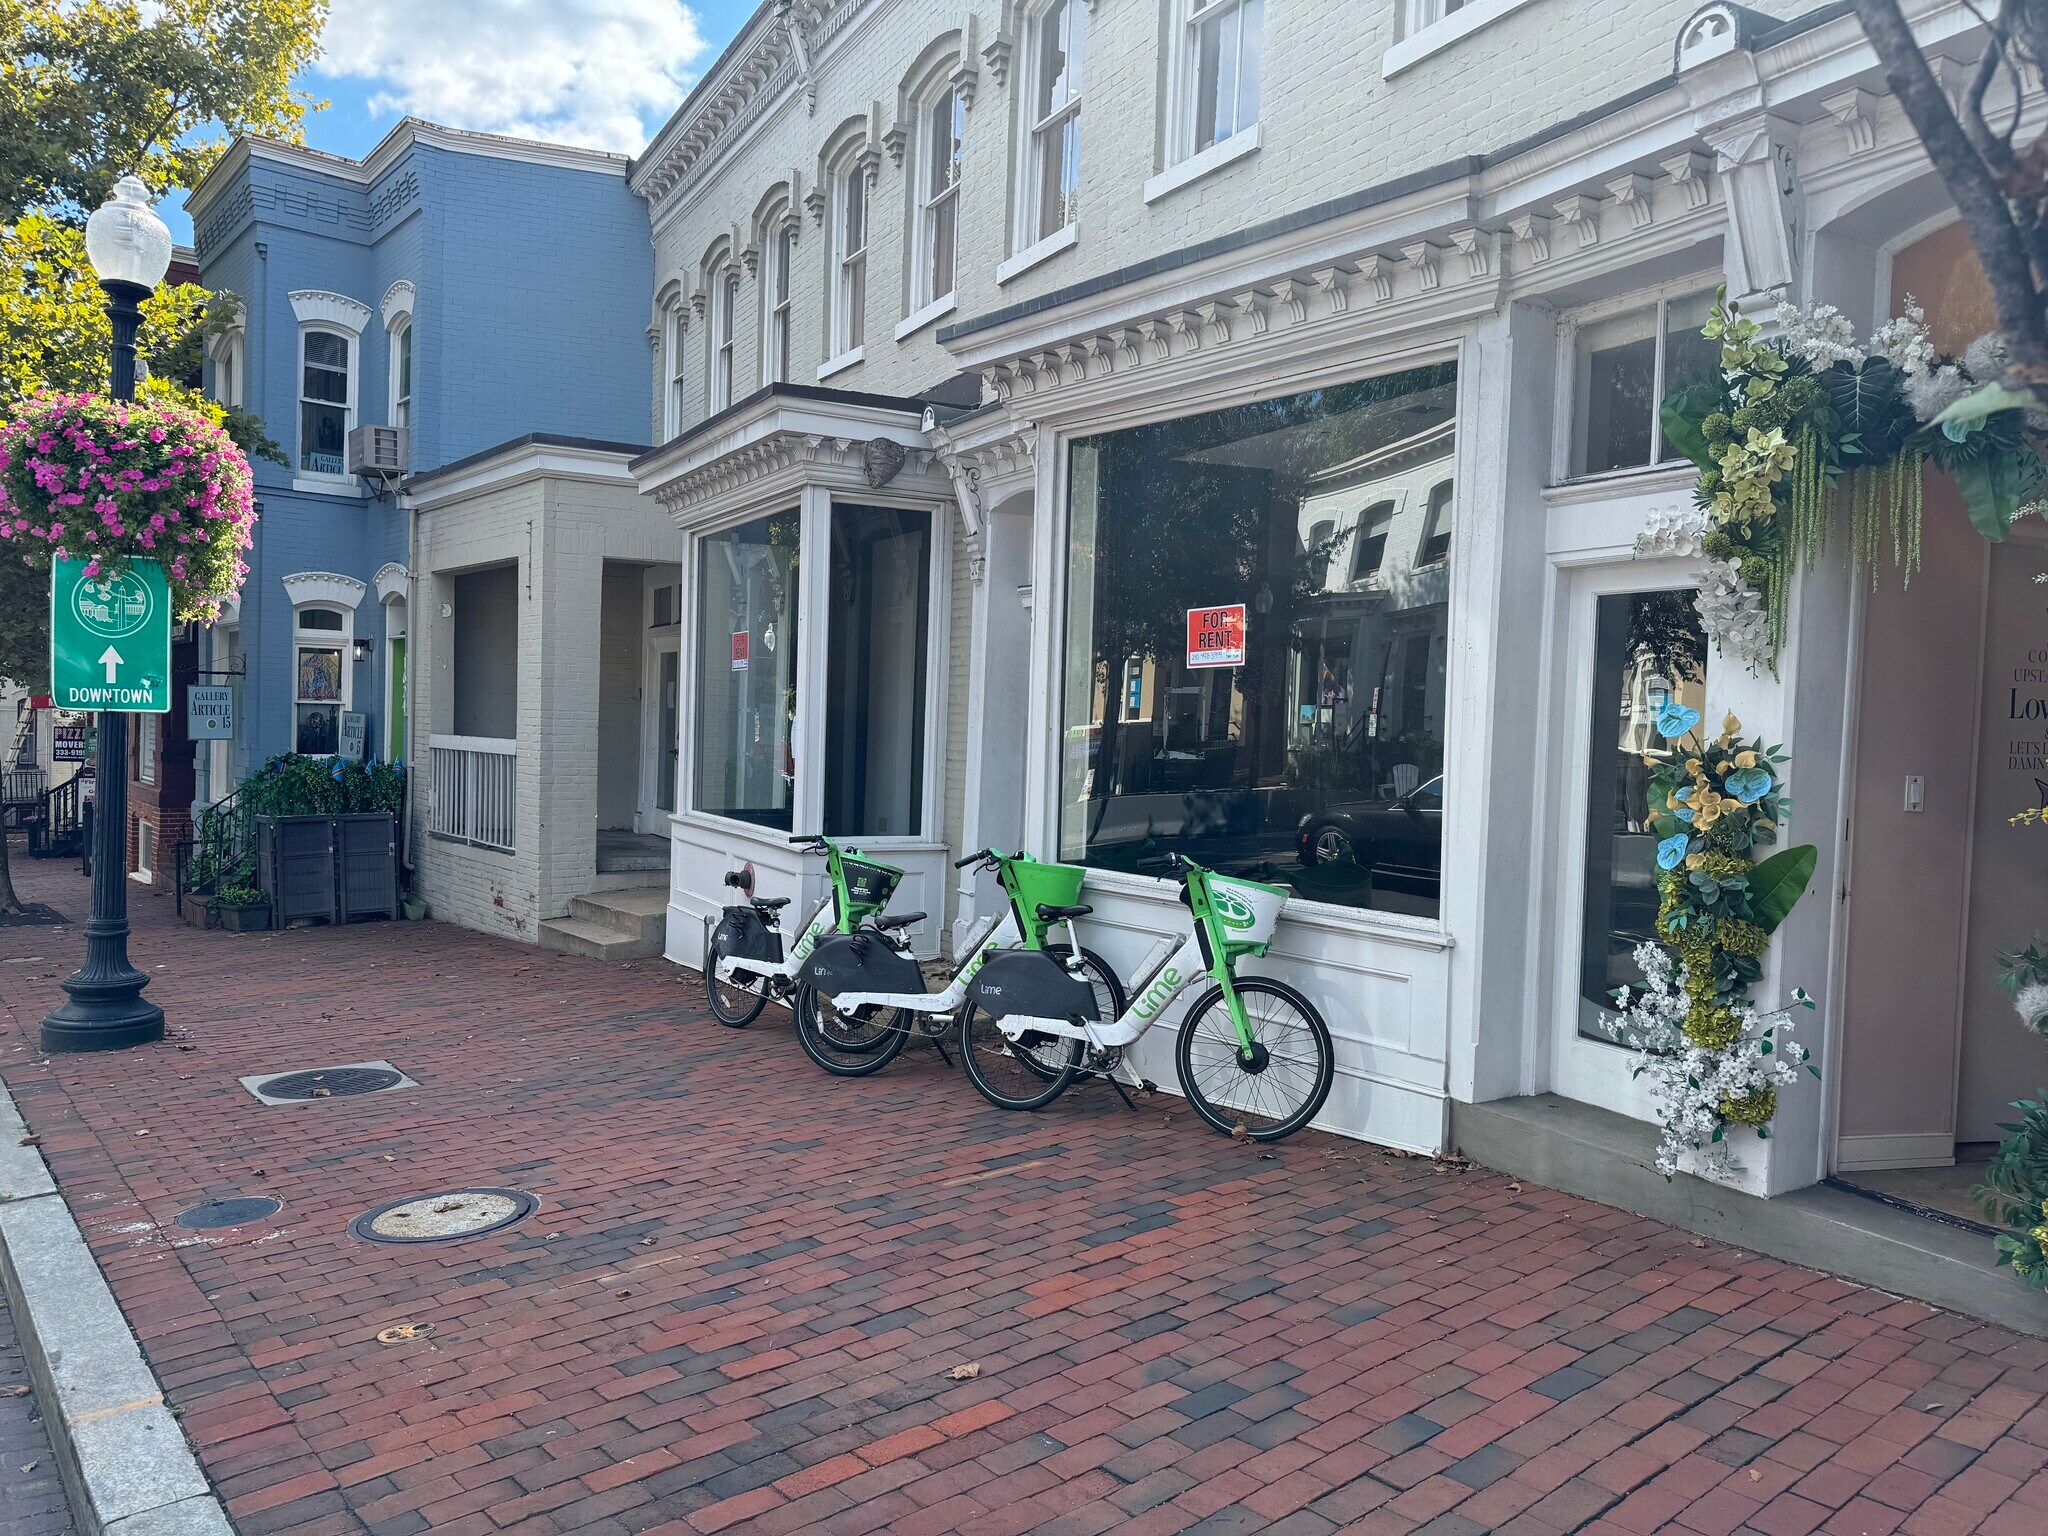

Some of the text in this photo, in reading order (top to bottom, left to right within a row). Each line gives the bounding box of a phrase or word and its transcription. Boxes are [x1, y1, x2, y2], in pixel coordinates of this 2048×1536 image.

[1203, 611, 1228, 629] FOR
[1198, 630, 1233, 649] RENT
[69, 687, 153, 705] DOWNTOWN
[194, 691, 229, 701] GALLERY
[190, 701, 231, 716] ARTICLE
[222, 716, 231, 729] 15
[2009, 741, 2040, 755] LET'S
[793, 922, 824, 960] Lime
[980, 984, 1002, 995] Lime
[1131, 967, 1183, 1019] Lime
